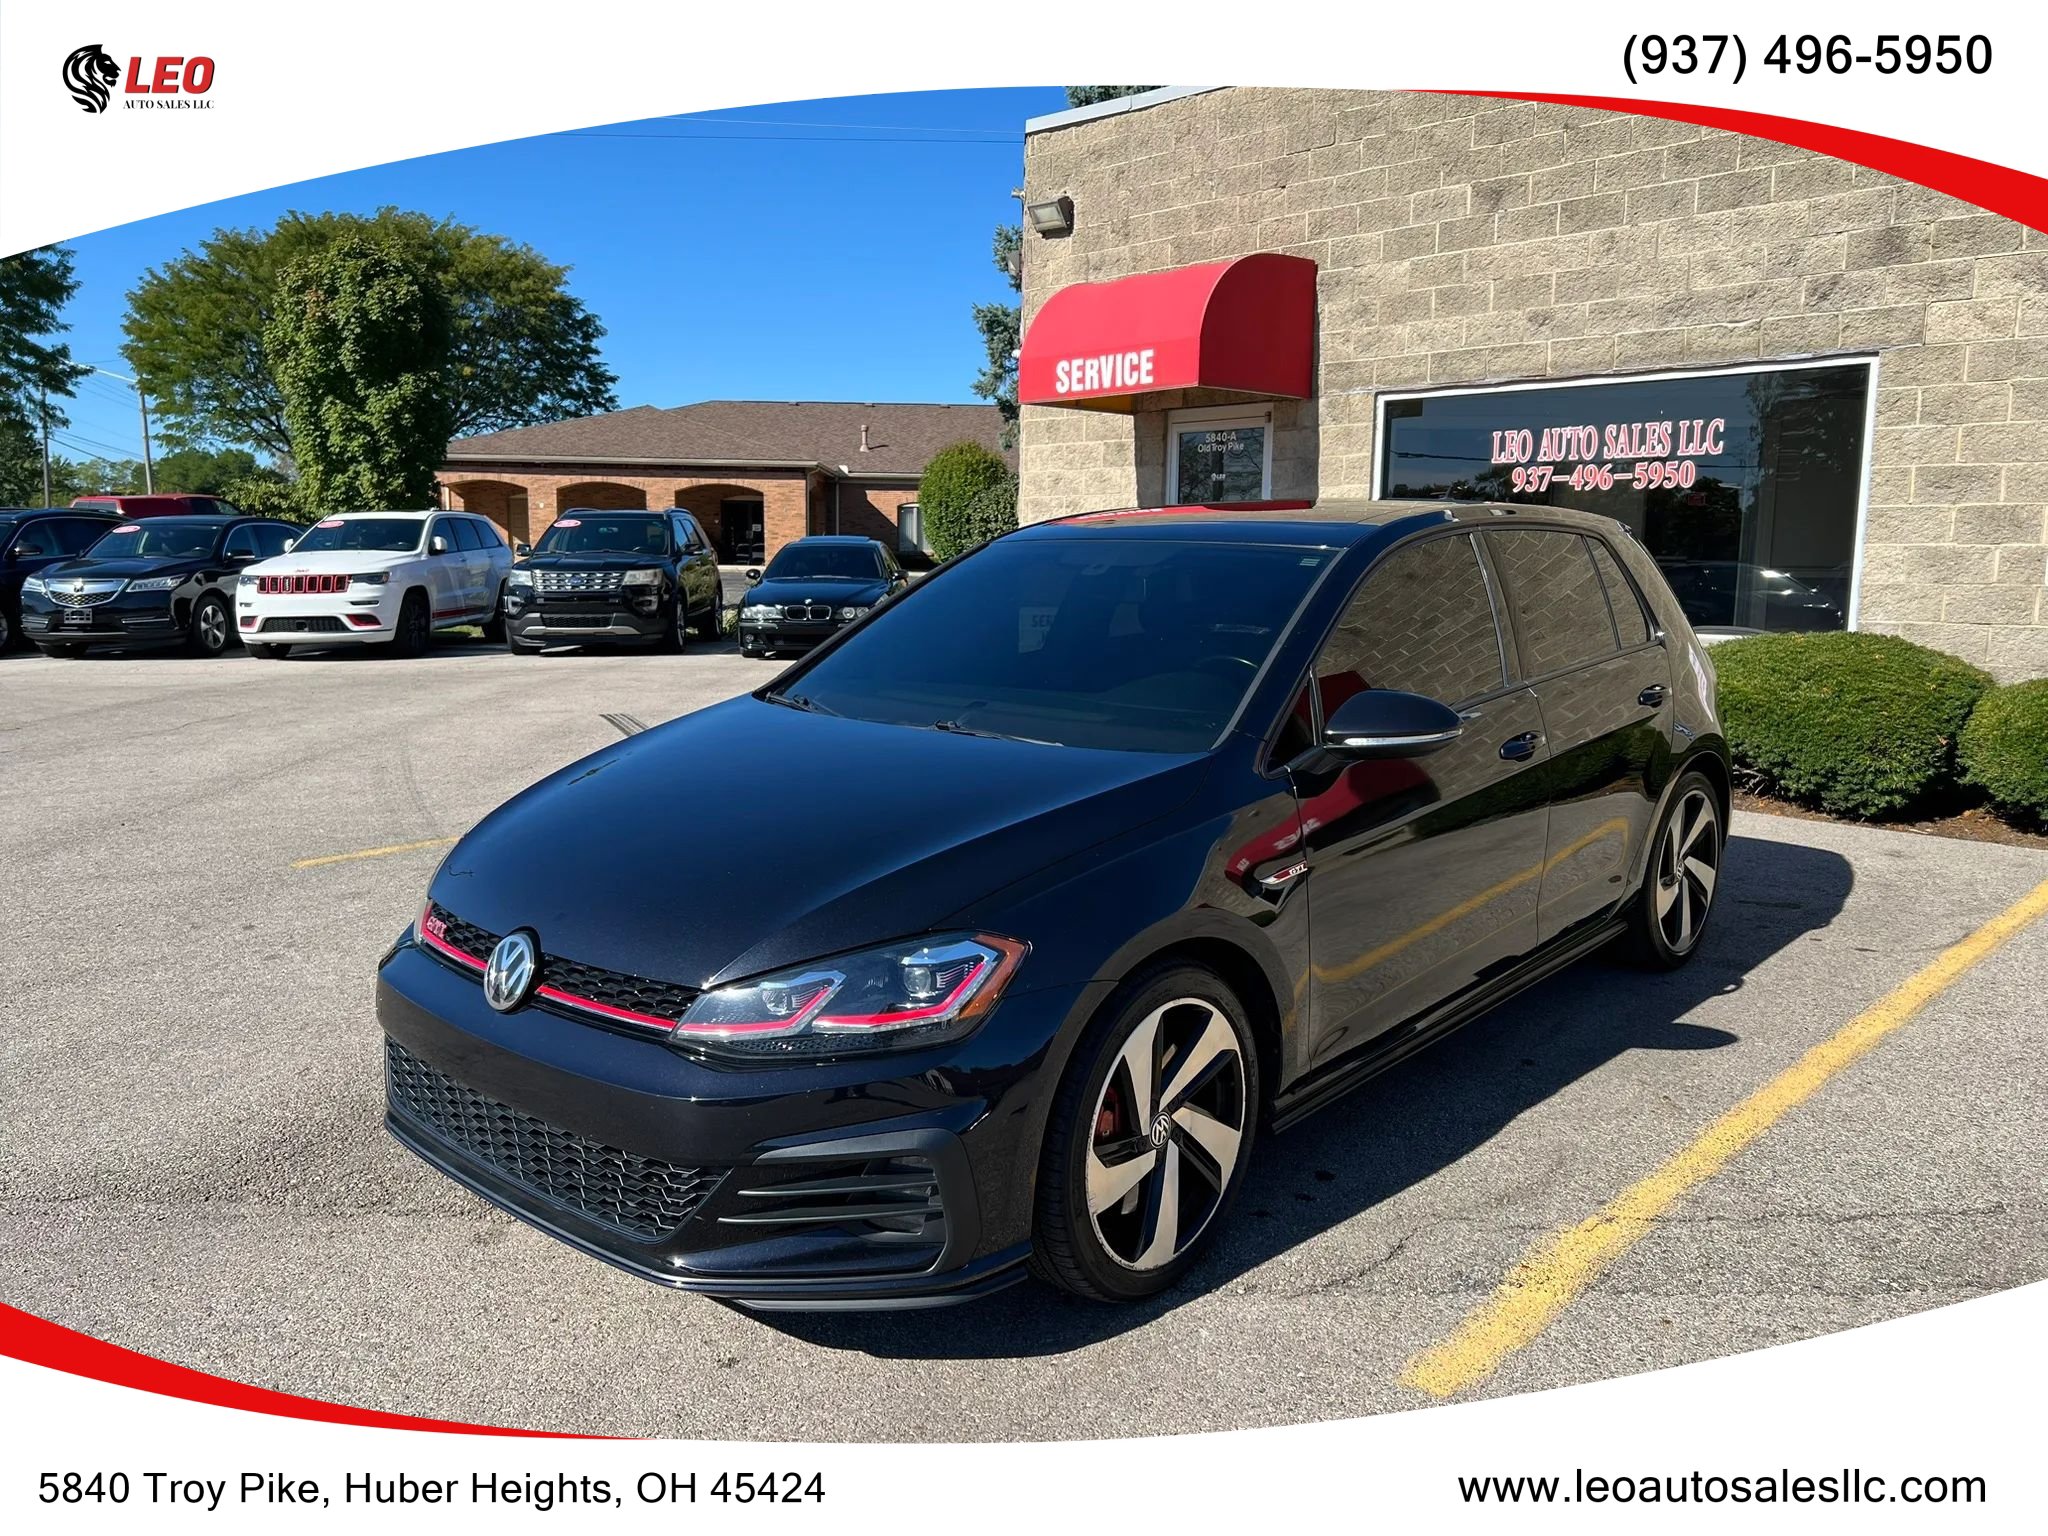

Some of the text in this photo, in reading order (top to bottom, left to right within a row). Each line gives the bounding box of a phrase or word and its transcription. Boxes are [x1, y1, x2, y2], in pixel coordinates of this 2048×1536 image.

[1055, 348, 1155, 394] SERVICE
[1197, 441, 1245, 454] Old Troy Pike
[1205, 431, 1237, 443] 5840-A
[1491, 418, 1726, 464] LEO AUTO SALES LLC
[1511, 460, 1696, 494] 937-496-5950
[1289, 863, 1308, 876] GTI
